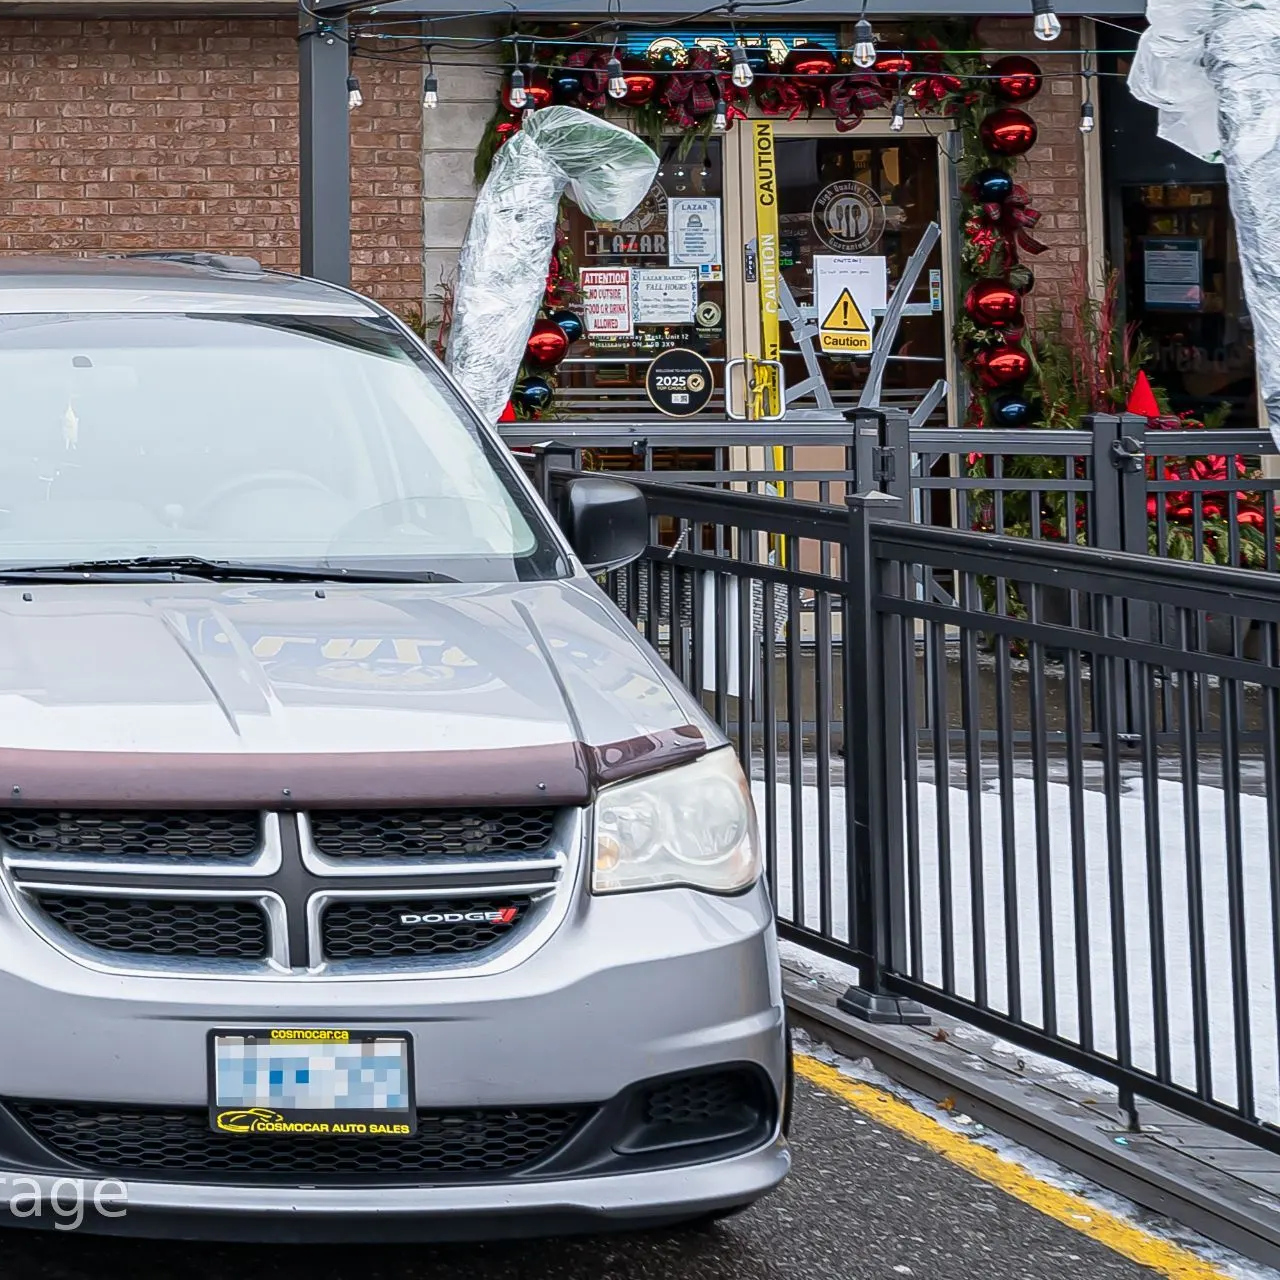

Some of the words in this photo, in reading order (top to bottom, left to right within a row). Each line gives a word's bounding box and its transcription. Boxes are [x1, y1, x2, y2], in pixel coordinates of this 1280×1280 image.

[757, 123, 774, 206] CAUTION
[596, 234, 666, 254] LAZAR
[584, 272, 627, 284] ATTENTION
[646, 283, 664, 291] FALL
[823, 335, 868, 347] Caution
[655, 376, 686, 387] 2025
[400, 911, 503, 924] DODGE
[271, 1029, 349, 1040] cosmocar.ca
[256, 1121, 329, 1132] COSMOCAR
[331, 1123, 367, 1133] AUTO
[369, 1123, 410, 1134] SALES
